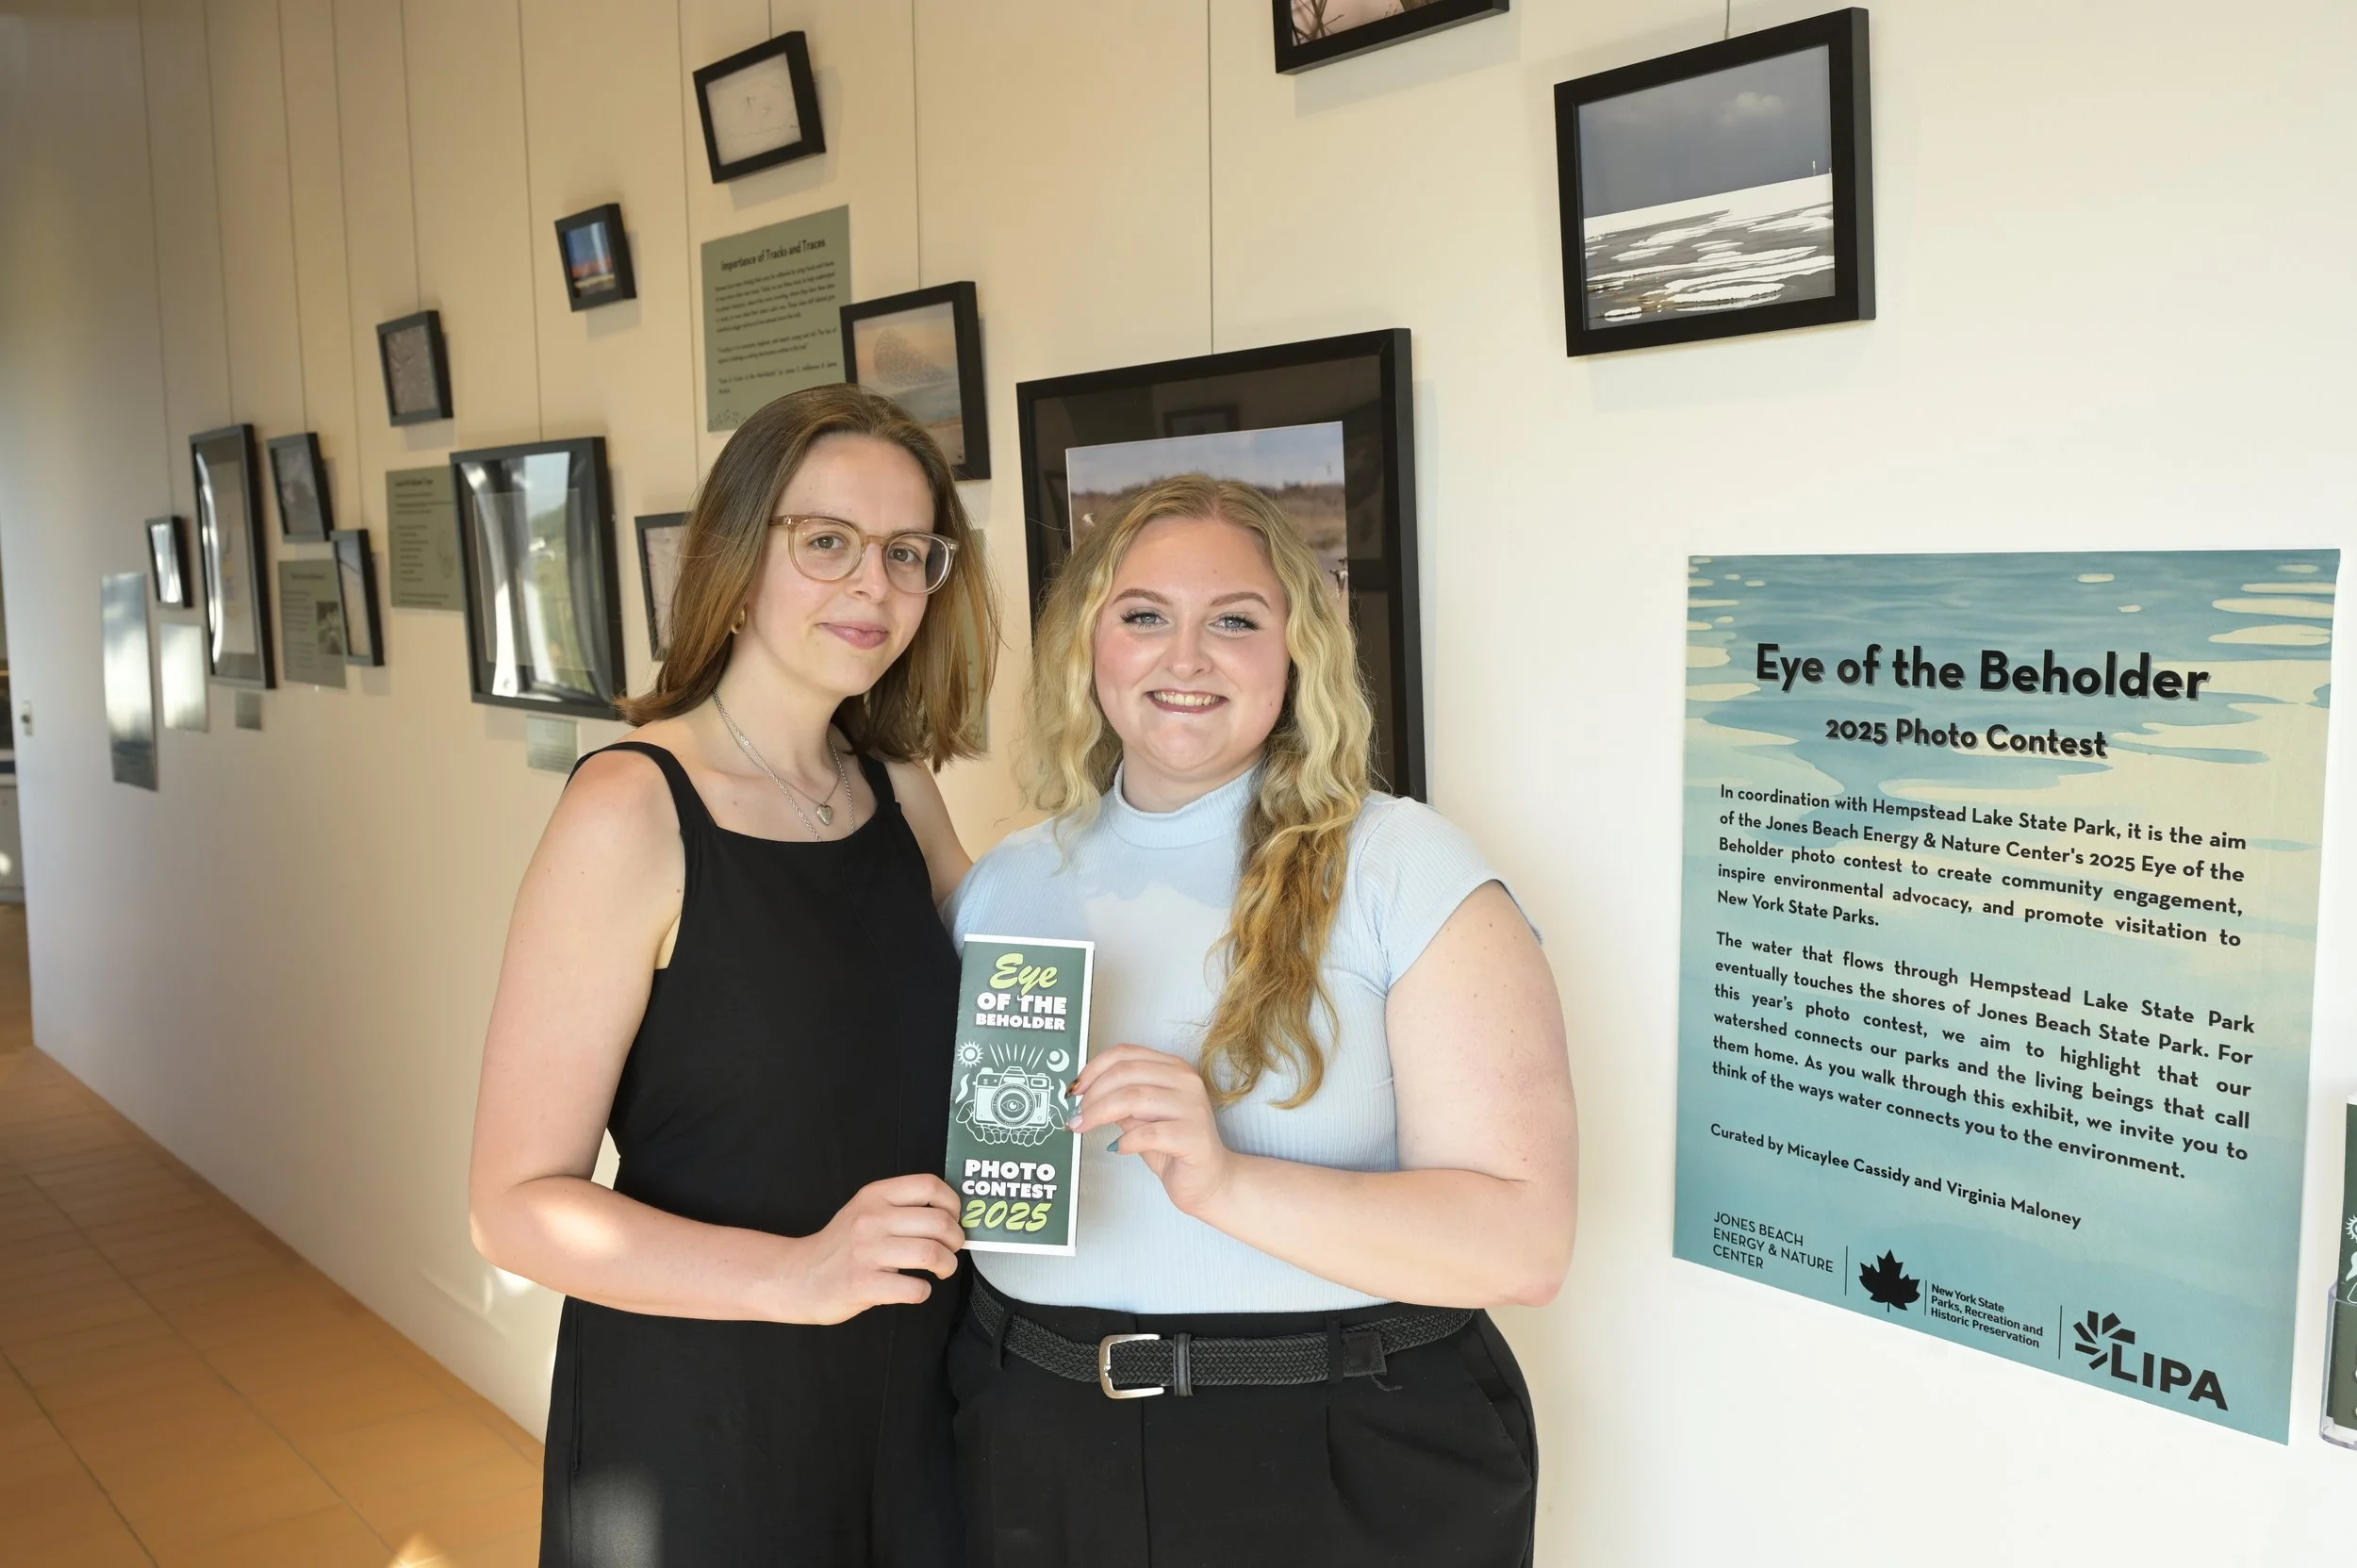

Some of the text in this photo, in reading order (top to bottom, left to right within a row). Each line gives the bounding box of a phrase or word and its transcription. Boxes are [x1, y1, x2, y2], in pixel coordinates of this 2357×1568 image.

[721, 239, 826, 272] Importance of Tracks and Traces
[1756, 643, 2209, 699] Eye of the Beholder
[1825, 718, 2106, 757] 2025 Photo Contest
[1721, 784, 2246, 850] In coordination with Hempstead Lake State Park, it is the aim
[1720, 810, 2245, 882] of the Jones Beach Energy & Nature Center's 2025 Eye of the
[1719, 836, 2243, 917] Beholder photo contest to create community engagement,
[1718, 863, 2241, 947] inspire environmental advocacy, and promote visitation to
[1718, 889, 1879, 926] New York State Parks.
[989, 952, 1058, 996] Eye
[1716, 931, 2254, 1033] The water that flows through Hempstead Lake State Park
[976, 1013, 1066, 1032] BEHOLDER
[977, 992, 1067, 1015] OF THE
[1715, 962, 2253, 1065] eventually touches the shores of Jones Beach State Park. For
[1714, 983, 1740, 1000] this
[1805, 1000, 1850, 1021] photo
[1863, 1015, 1928, 1038] contest,
[1941, 1030, 1966, 1043] we
[1980, 1033, 2010, 1052] aim
[2026, 1041, 2044, 1058] to
[2060, 1046, 2140, 1077] highlight
[2157, 1065, 2199, 1087] that
[2217, 1081, 2251, 1097] our
[1713, 1013, 2250, 1129] watershed connects our parks and the living beings that call
[1712, 1034, 2248, 1161] them home. As you walk through this exhibit, we invite you to
[1712, 1061, 2185, 1179] think of the ways water connects you to the environment.
[962, 1180, 1057, 1199] CONTEST
[964, 1159, 1056, 1181] PHOTO
[1710, 1123, 2082, 1230] Curated by Micaylee Cassidy and Virginia Maloney
[962, 1199, 1053, 1233] 2025
[1713, 1211, 1804, 1246] JONES BEACH
[1712, 1244, 1764, 1269] CENTER
[1713, 1227, 1834, 1273] ENERGY & NATURE
[1931, 1283, 2004, 1313] New York State
[1931, 1295, 2043, 1337] Parks, Recreation and
[1931, 1307, 2039, 1348] Historic Preservation
[2111, 1343, 2229, 1411] LIPA
